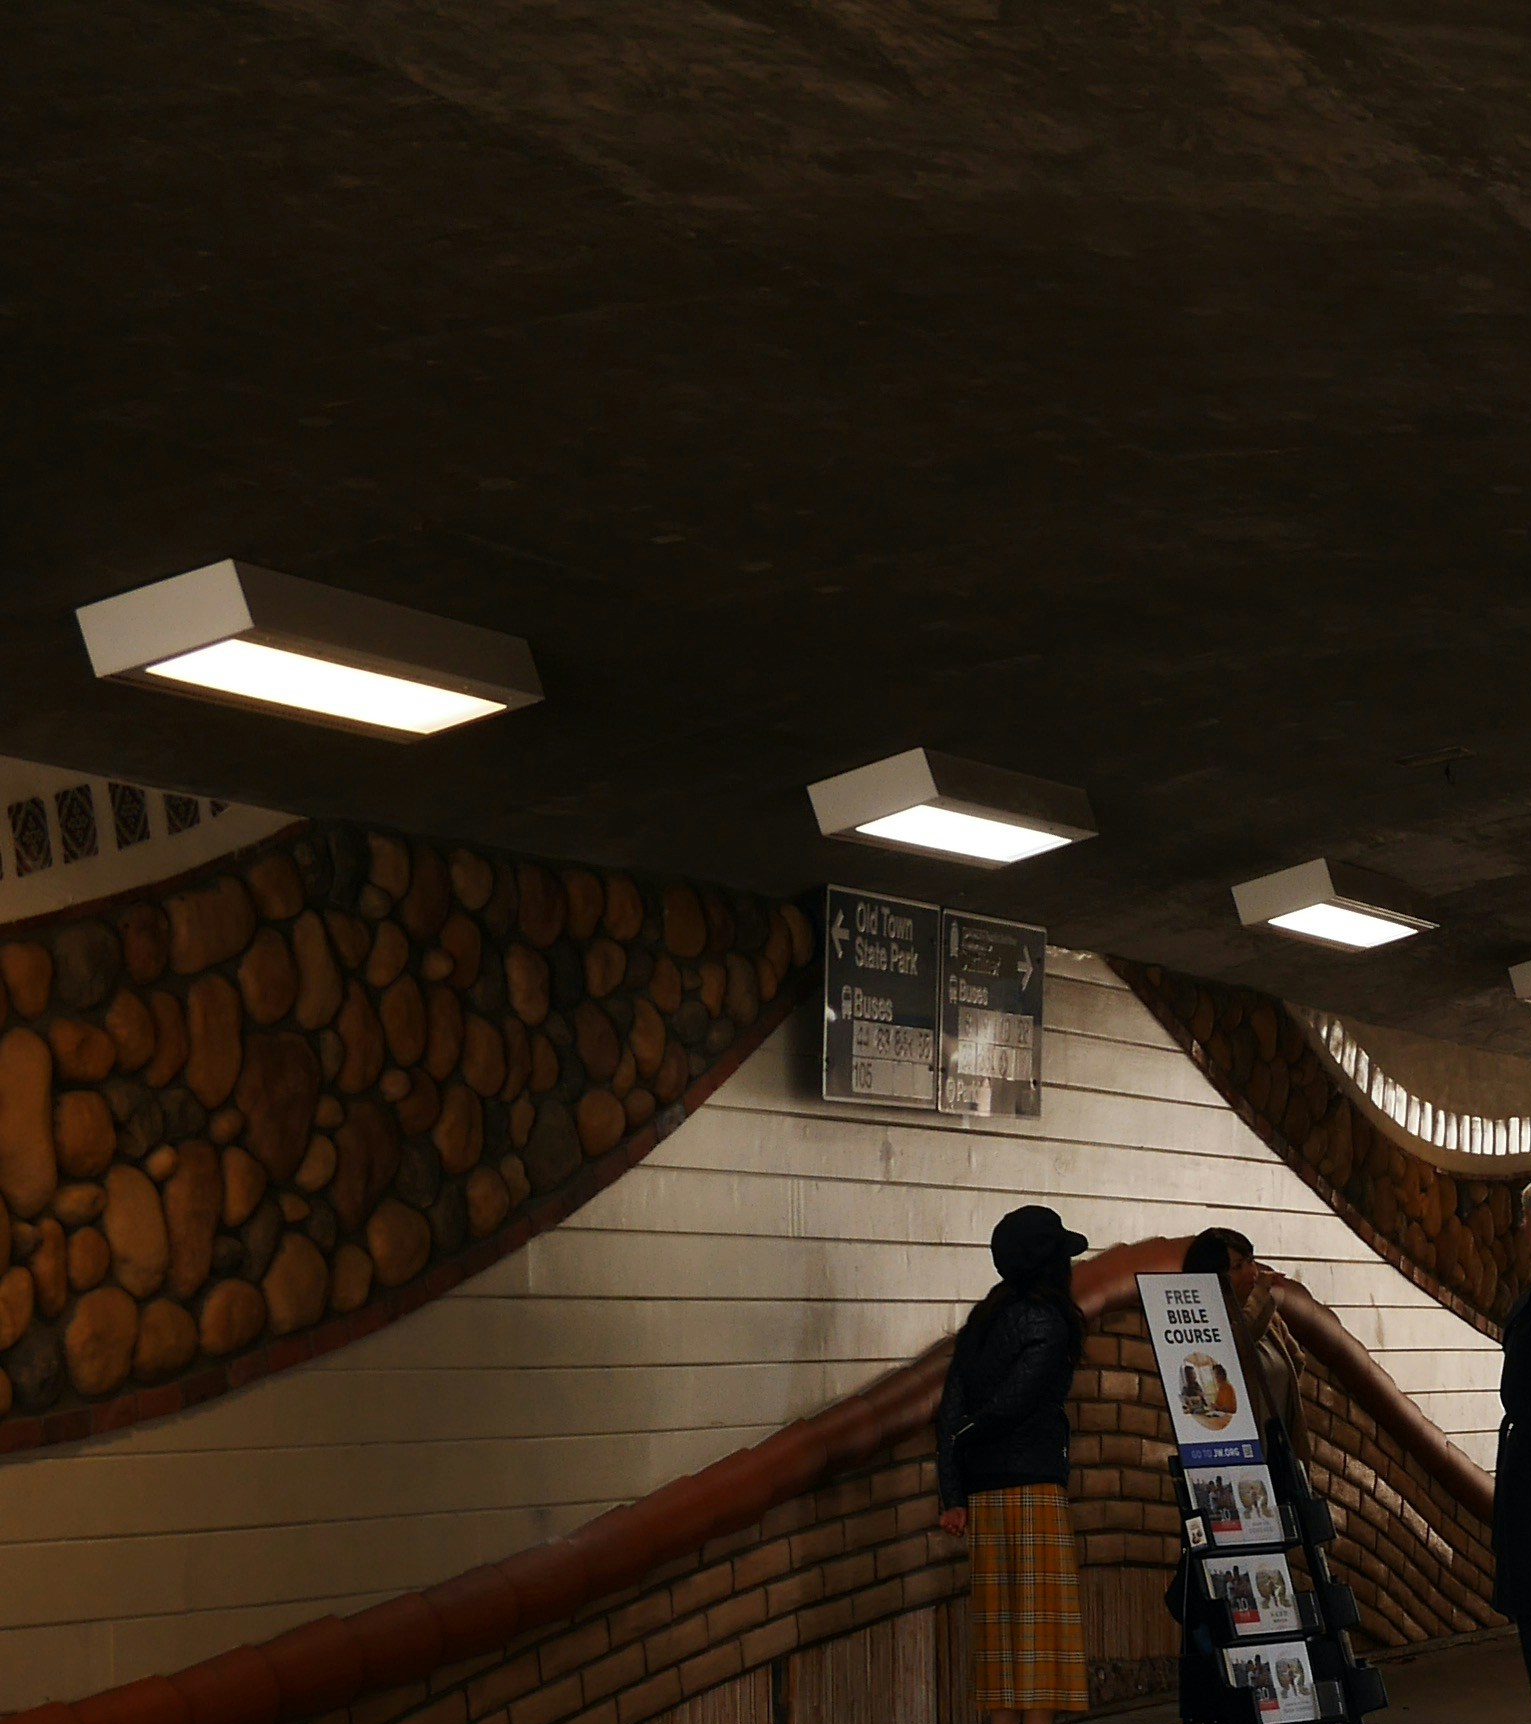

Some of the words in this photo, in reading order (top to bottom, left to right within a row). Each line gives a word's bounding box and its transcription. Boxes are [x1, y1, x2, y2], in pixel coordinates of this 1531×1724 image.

[856, 901, 878, 935] Old
[881, 906, 914, 941] Town
[855, 936, 887, 971] State
[890, 942, 919, 976] Park
[854, 986, 894, 1022] Buses
[959, 978, 989, 1006] Buses
[854, 1062, 873, 1089] 105
[1165, 1289, 1201, 1305] FREE
[1167, 1309, 1209, 1325] BIBLE
[1164, 1328, 1222, 1345] COURSE
[1213, 1447, 1240, 1458] JW.ORG
